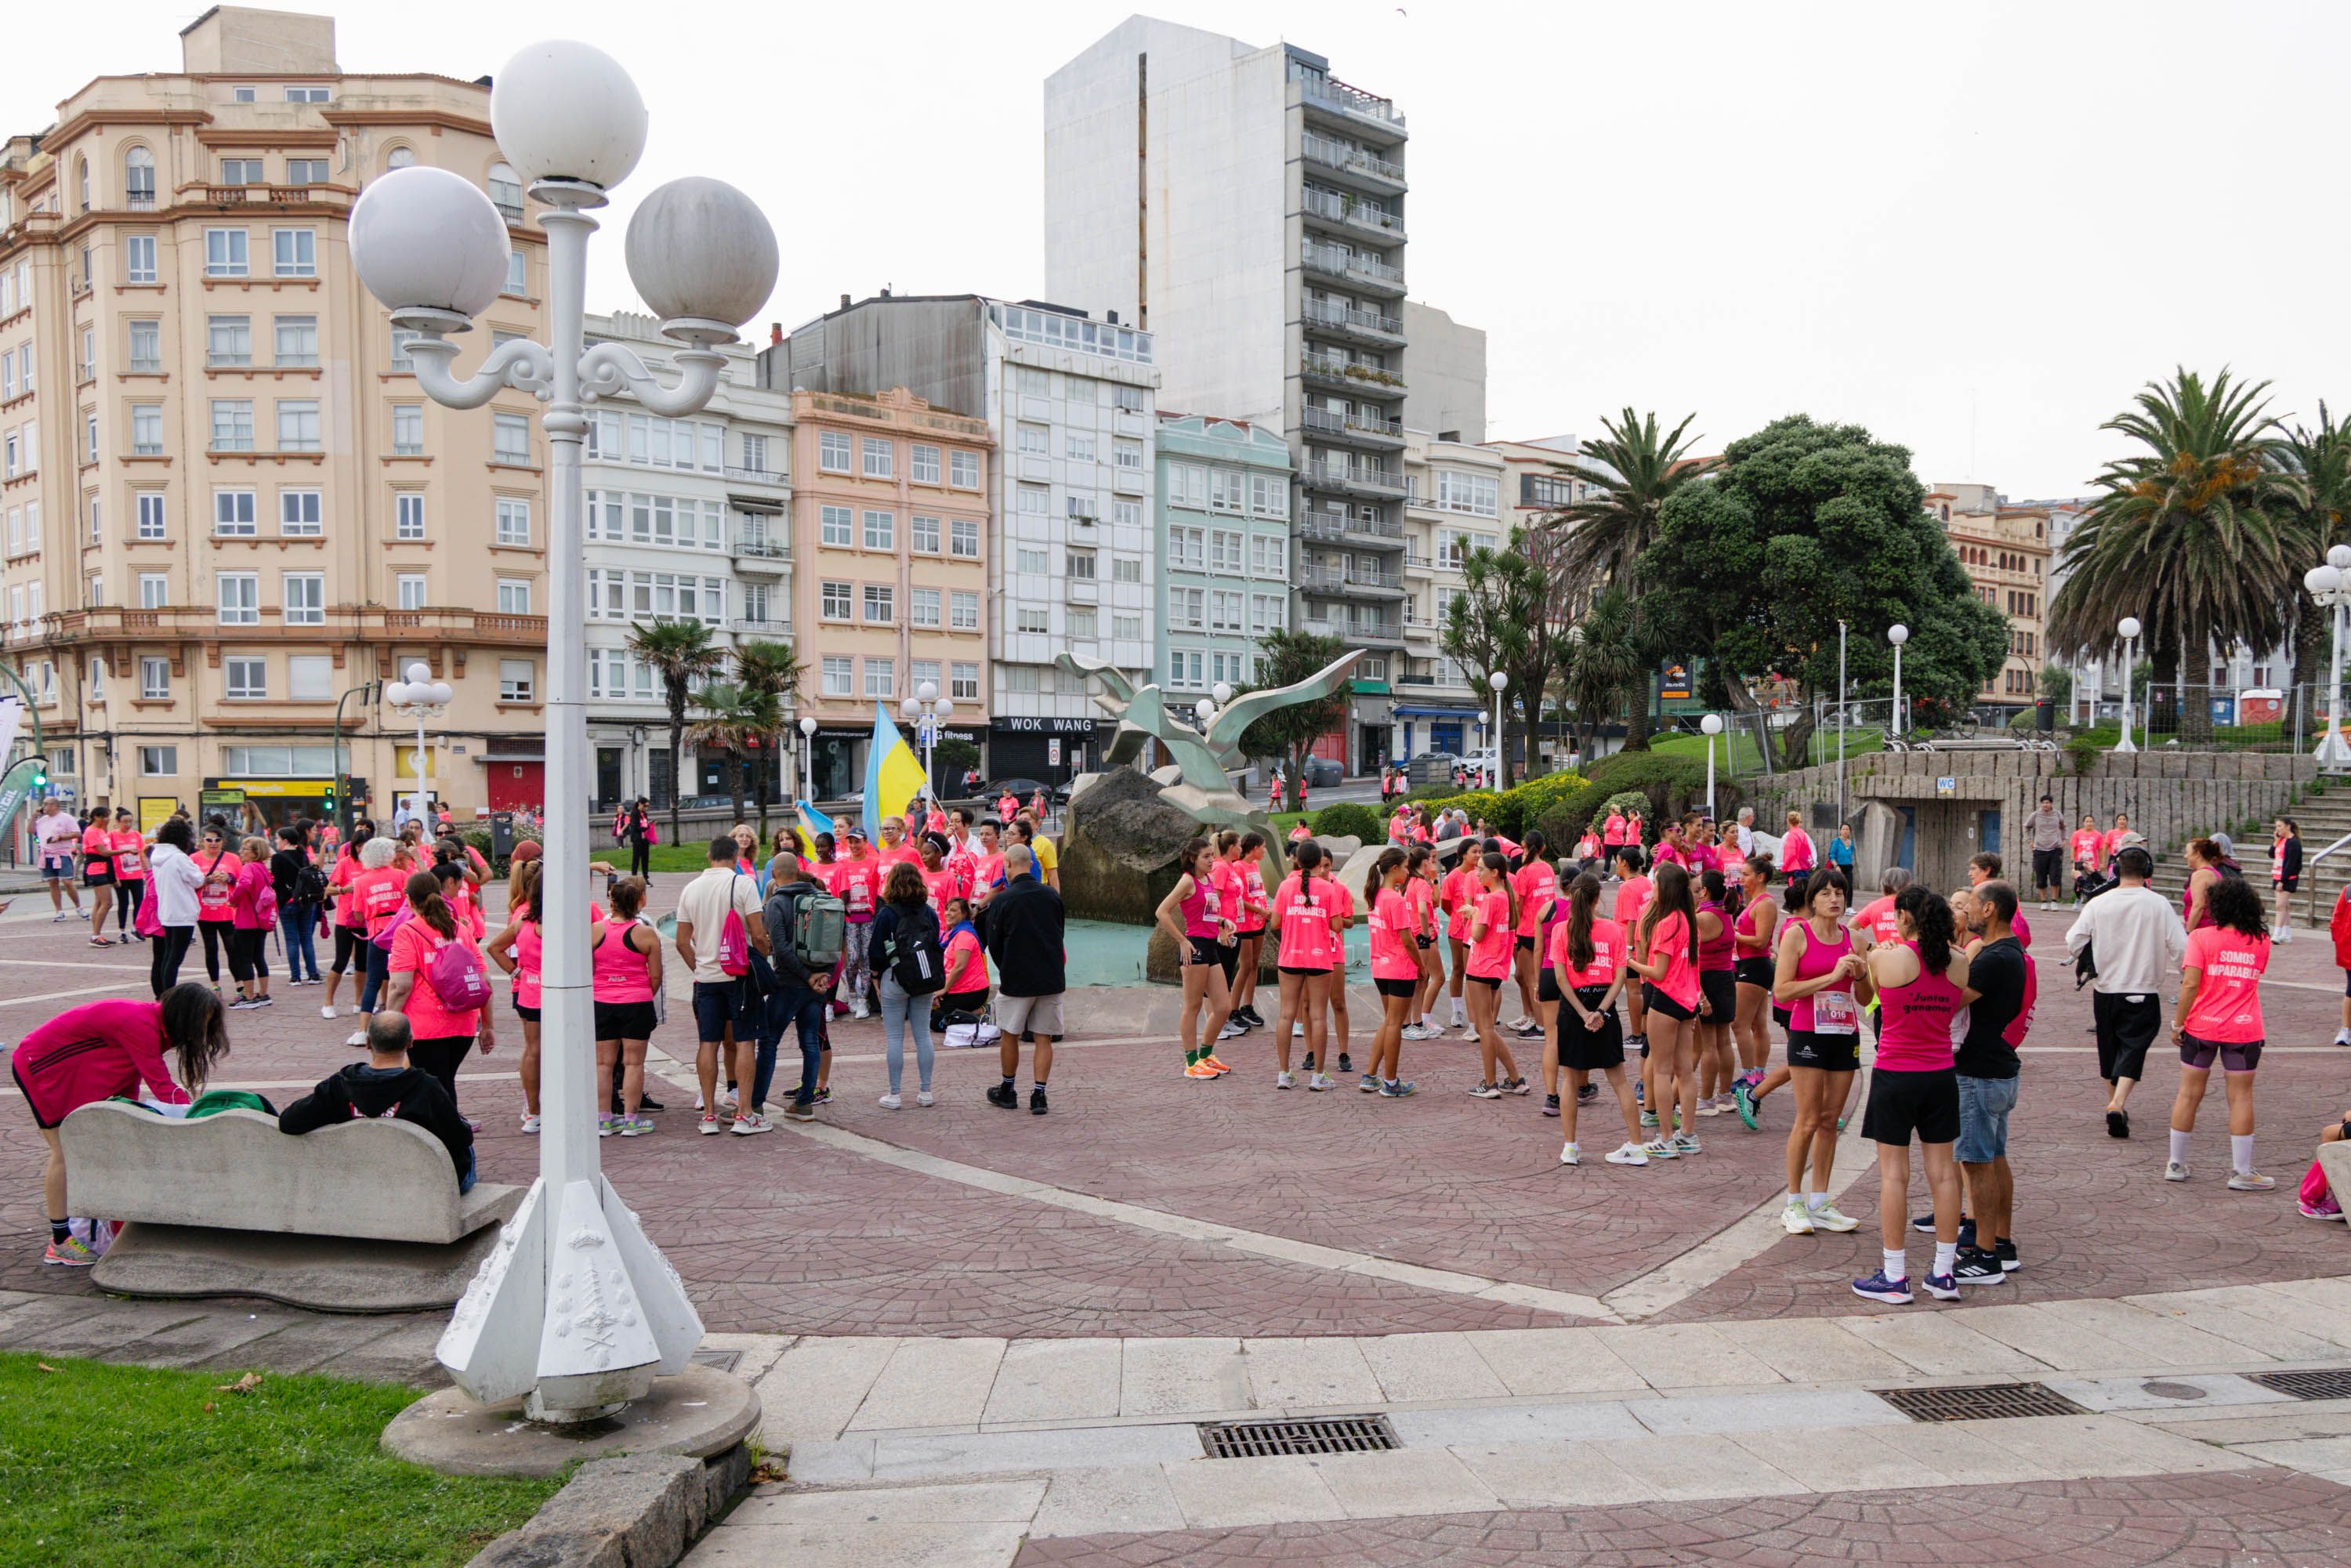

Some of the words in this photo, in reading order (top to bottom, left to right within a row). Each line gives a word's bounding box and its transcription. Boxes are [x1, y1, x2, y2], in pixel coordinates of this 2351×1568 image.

[1011, 718, 1041, 730] WOK
[1053, 719, 1092, 731] WANG
[944, 730, 973, 741] fitness
[1939, 778, 1954, 788] WC
[1294, 895, 1320, 905] SOOS
[2219, 950, 2255, 965] SOMOS
[2207, 964, 2260, 980] IMPARABLE
[1830, 1010, 1846, 1019] 016
